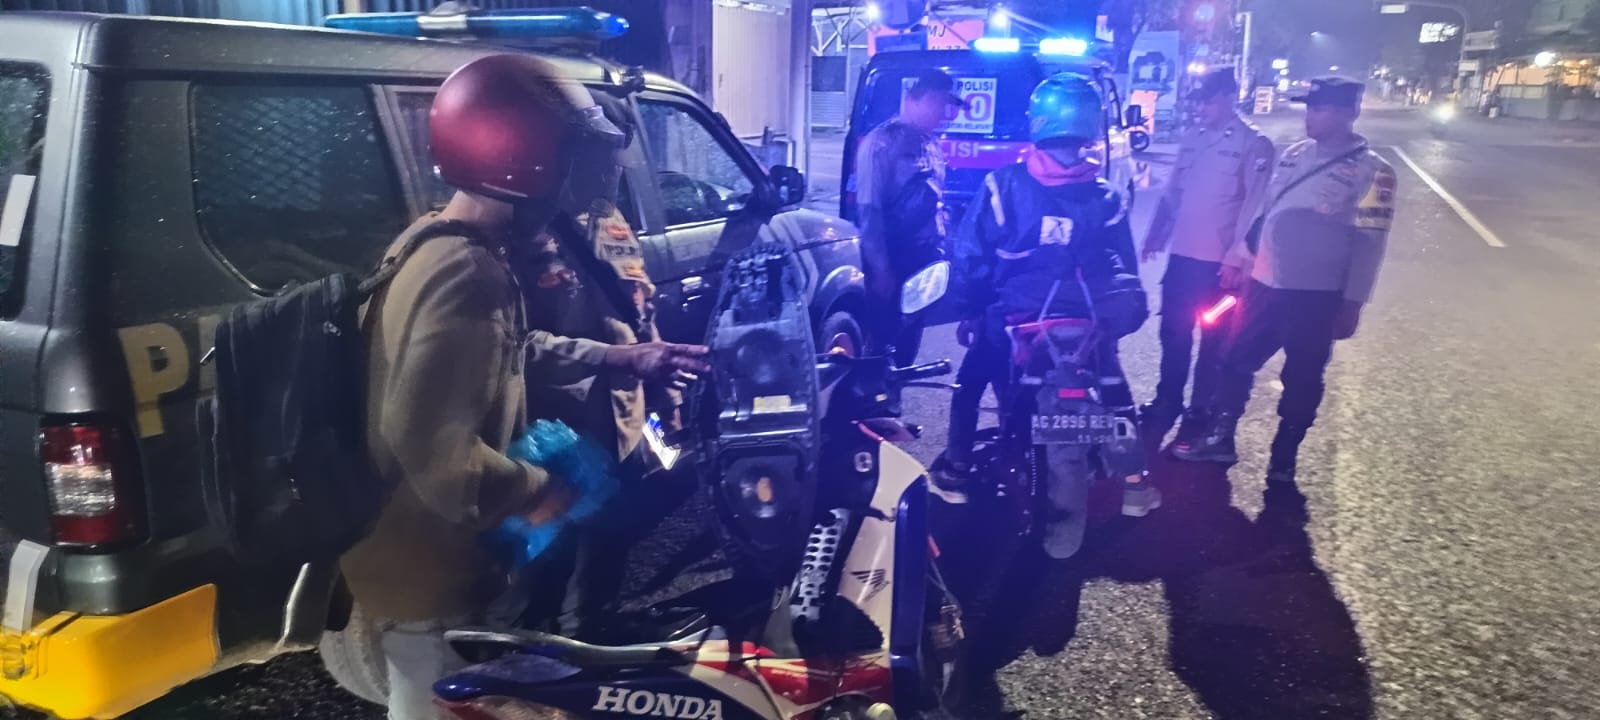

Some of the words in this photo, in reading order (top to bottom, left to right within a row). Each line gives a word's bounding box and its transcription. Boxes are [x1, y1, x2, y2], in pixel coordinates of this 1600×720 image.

[956, 81, 993, 92] POLISI
[1031, 415, 1049, 429] AG
[592, 686, 723, 720] HONDA
